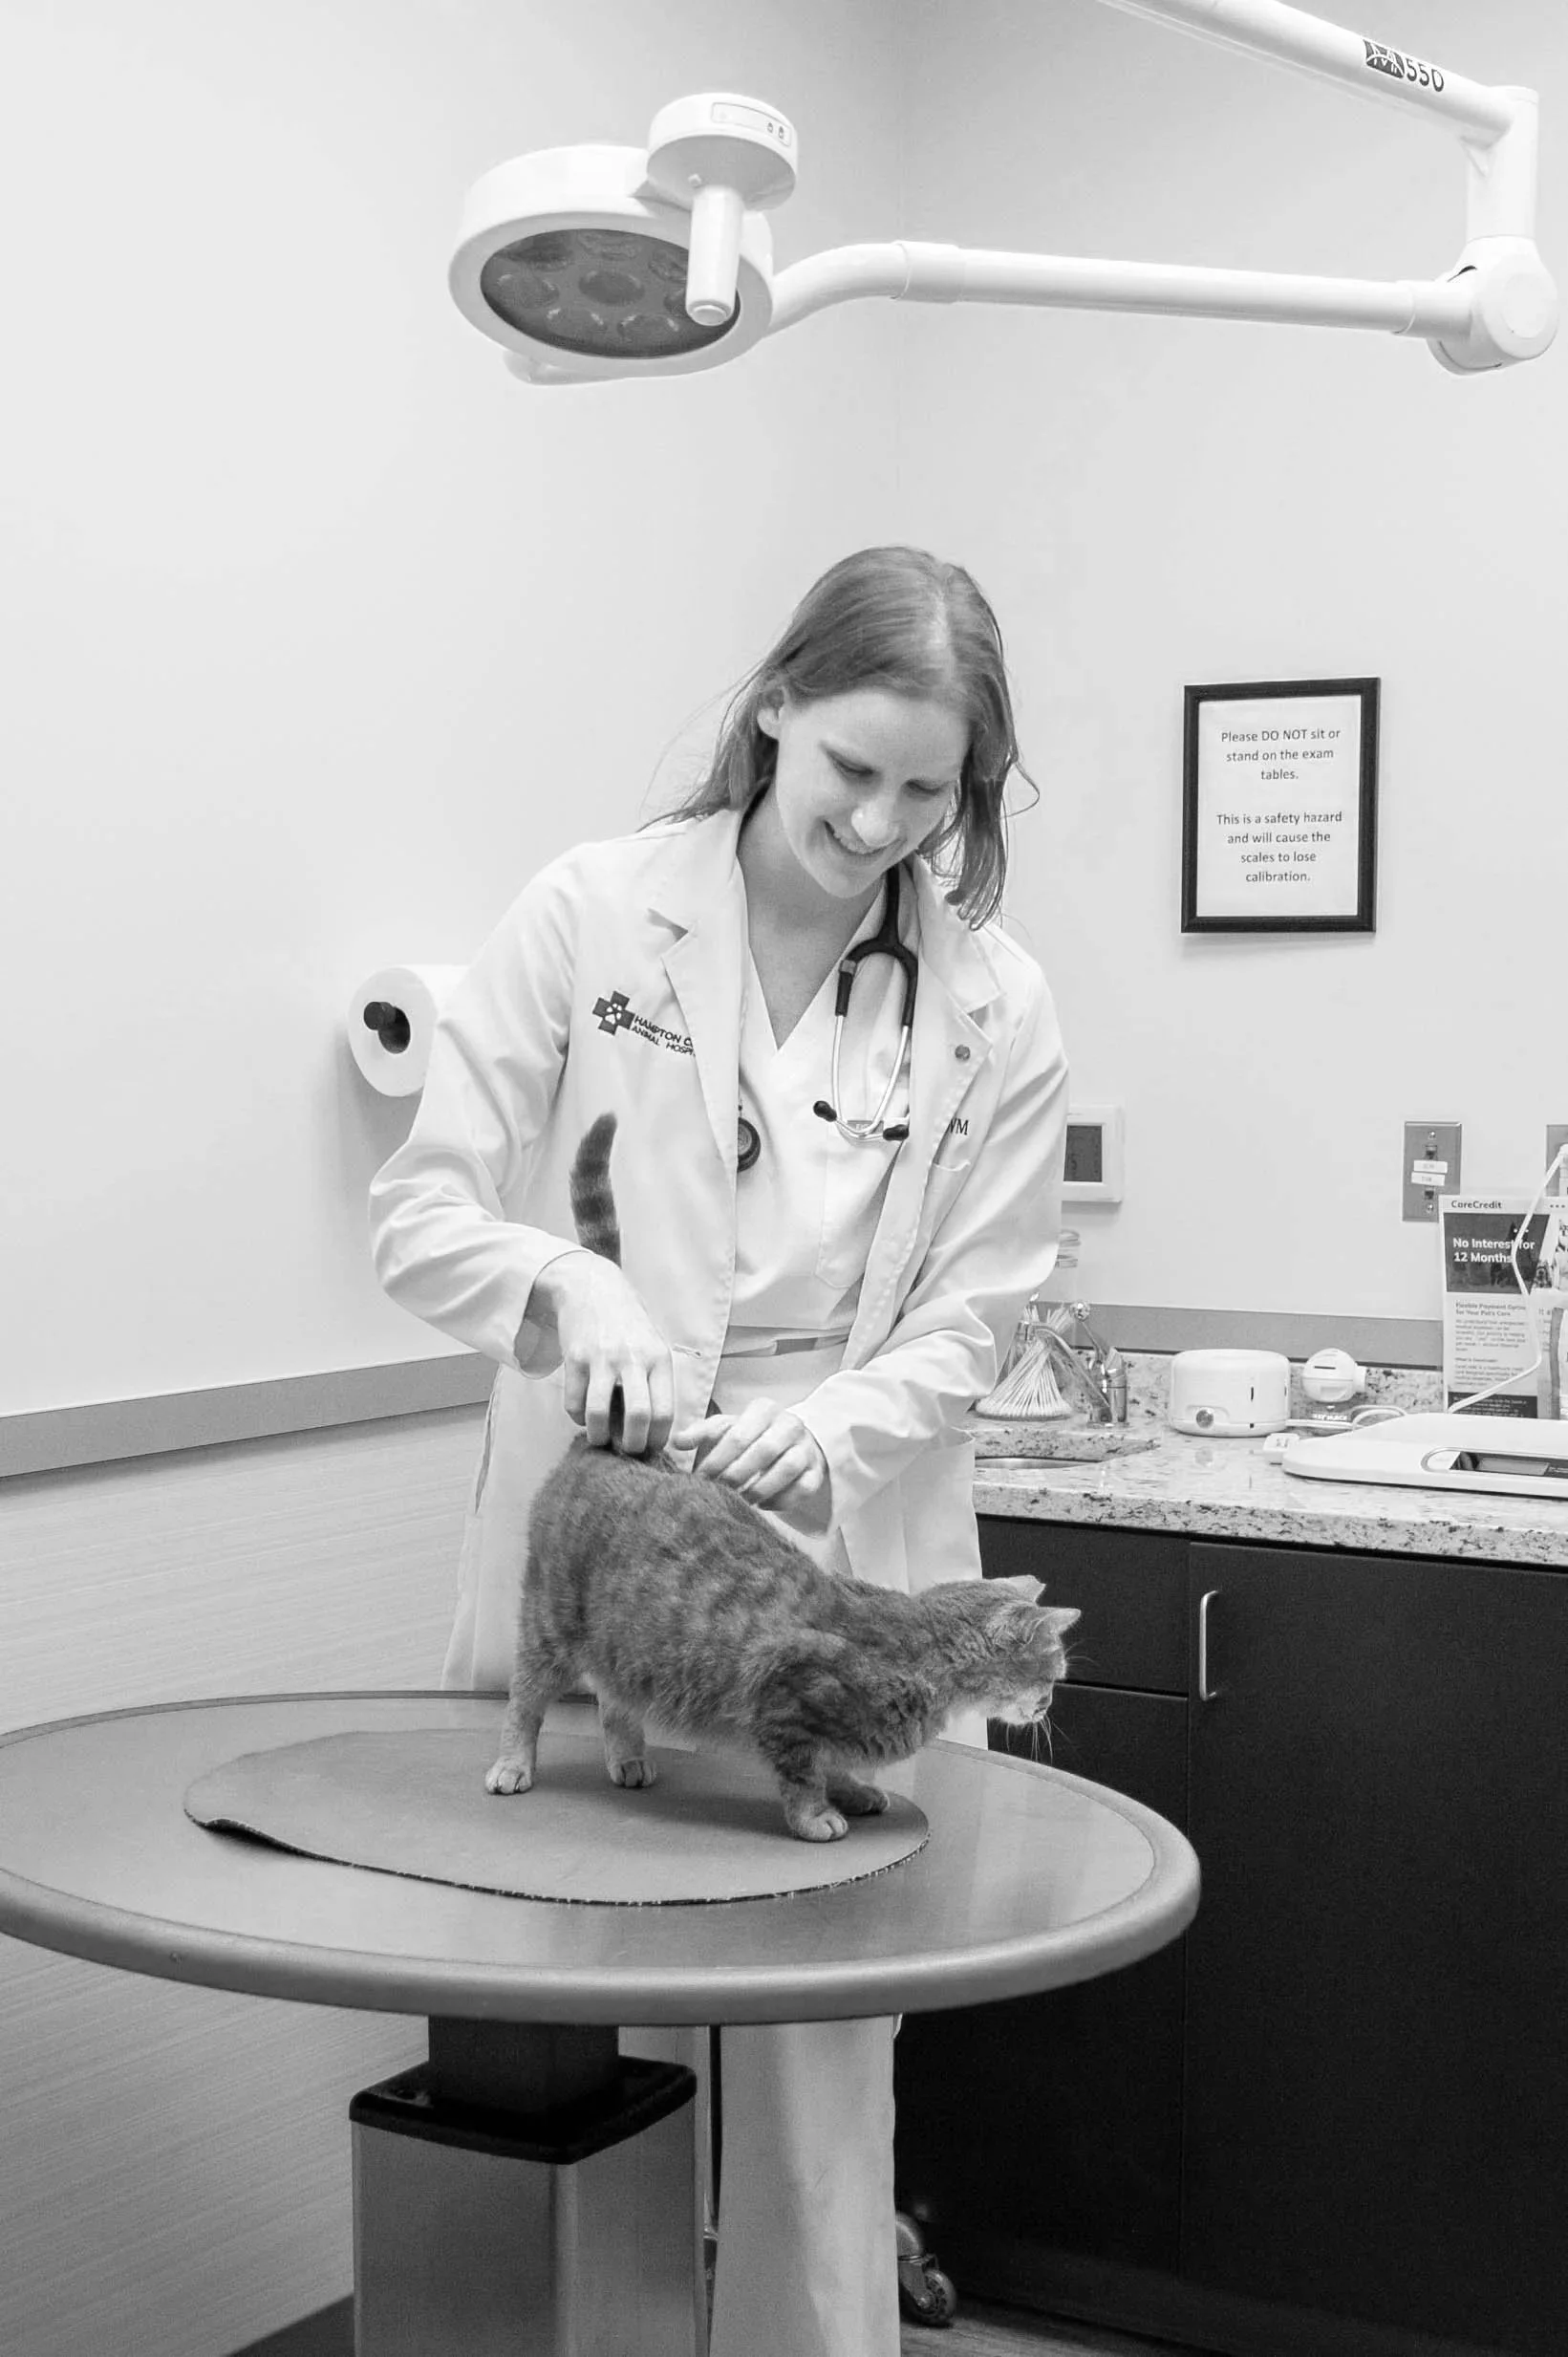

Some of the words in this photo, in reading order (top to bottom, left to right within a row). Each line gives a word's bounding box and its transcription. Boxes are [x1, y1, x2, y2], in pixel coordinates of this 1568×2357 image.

[1405, 57, 1445, 92] 550
[1221, 731, 1258, 742] Please
[1261, 730, 1279, 741] DO
[1282, 728, 1307, 740] NOT
[1310, 728, 1325, 739] sit
[1328, 729, 1341, 739] or
[1226, 750, 1259, 762] stand
[1262, 751, 1277, 761] on
[1280, 749, 1299, 760] the
[1302, 749, 1334, 759] exam
[1261, 768, 1300, 780] tables.
[1217, 813, 1240, 825] This
[1243, 813, 1252, 824] is
[1255, 815, 1261, 824] a
[1264, 812, 1300, 825] safety
[1303, 811, 1342, 822] hazard
[1227, 833, 1249, 844] and
[1252, 832, 1273, 843] will
[1276, 833, 1309, 843] cause
[1311, 831, 1331, 842] the
[1241, 852, 1275, 863] scales
[1278, 853, 1290, 862] to
[1293, 851, 1317, 861] lose
[1246, 871, 1311, 882] calibration.
[634, 1015, 681, 1044] HAMPTON
[665, 1042, 697, 1057] HOSPI
[1450, 1200, 1502, 1209] CareCredit
[1452, 1238, 1470, 1248] No
[1454, 1252, 1469, 1263] 12
